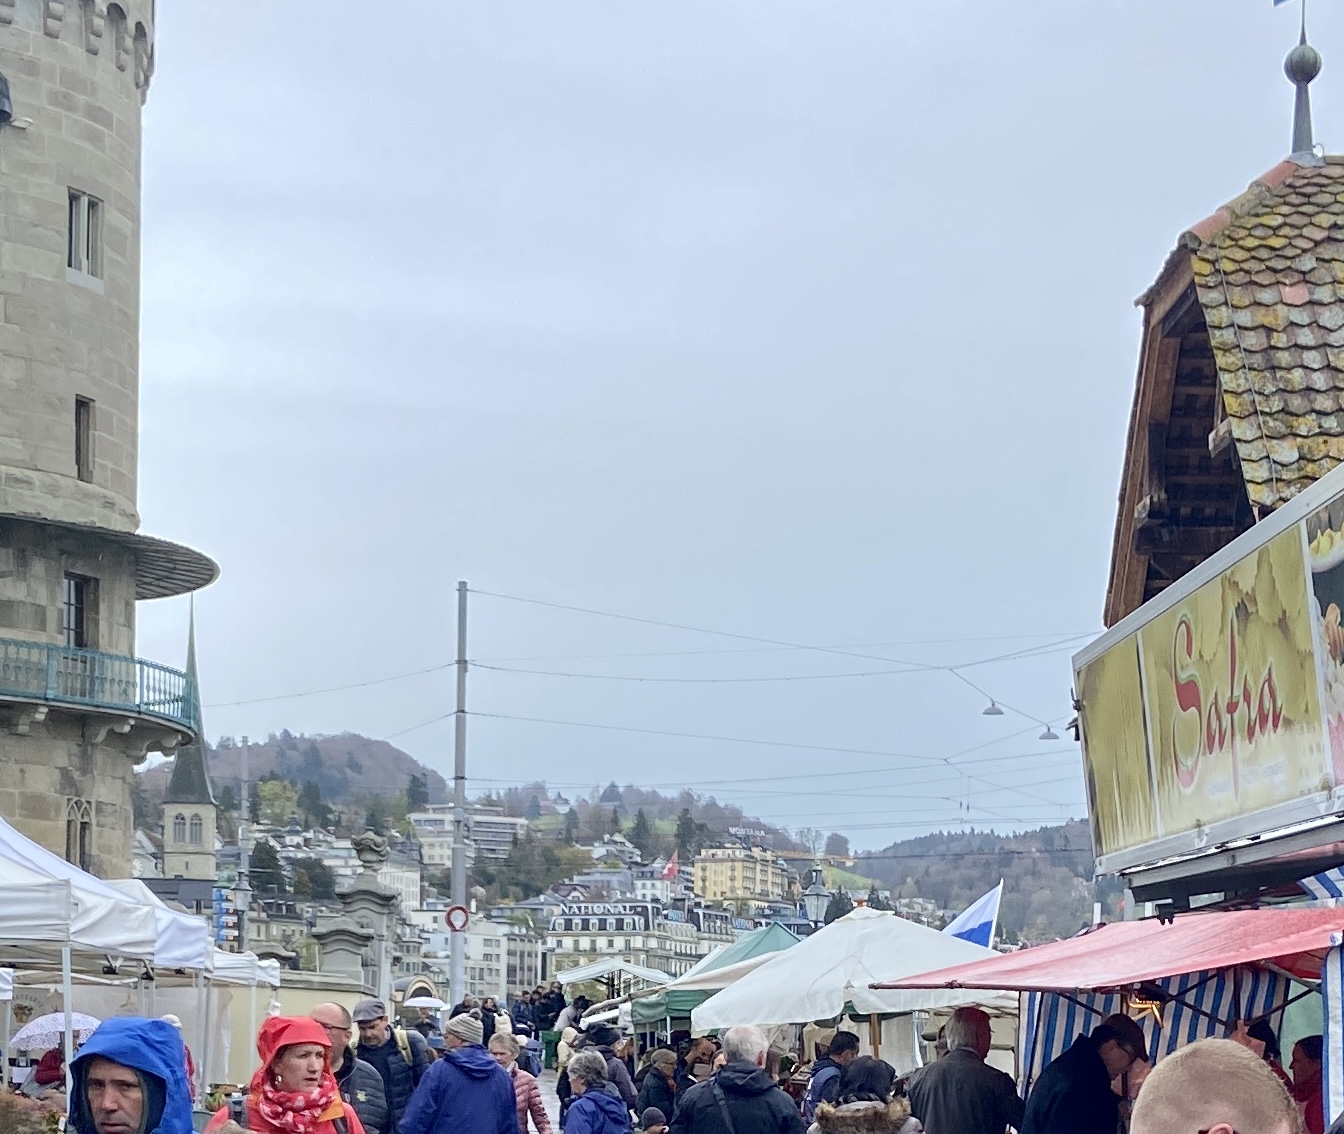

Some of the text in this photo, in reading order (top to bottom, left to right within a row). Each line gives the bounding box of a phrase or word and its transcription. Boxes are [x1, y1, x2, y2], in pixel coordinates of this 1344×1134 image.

[1172, 614, 1284, 799] Safra
[728, 826, 766, 836] MONTANA
[560, 902, 635, 915] NATIONAL
